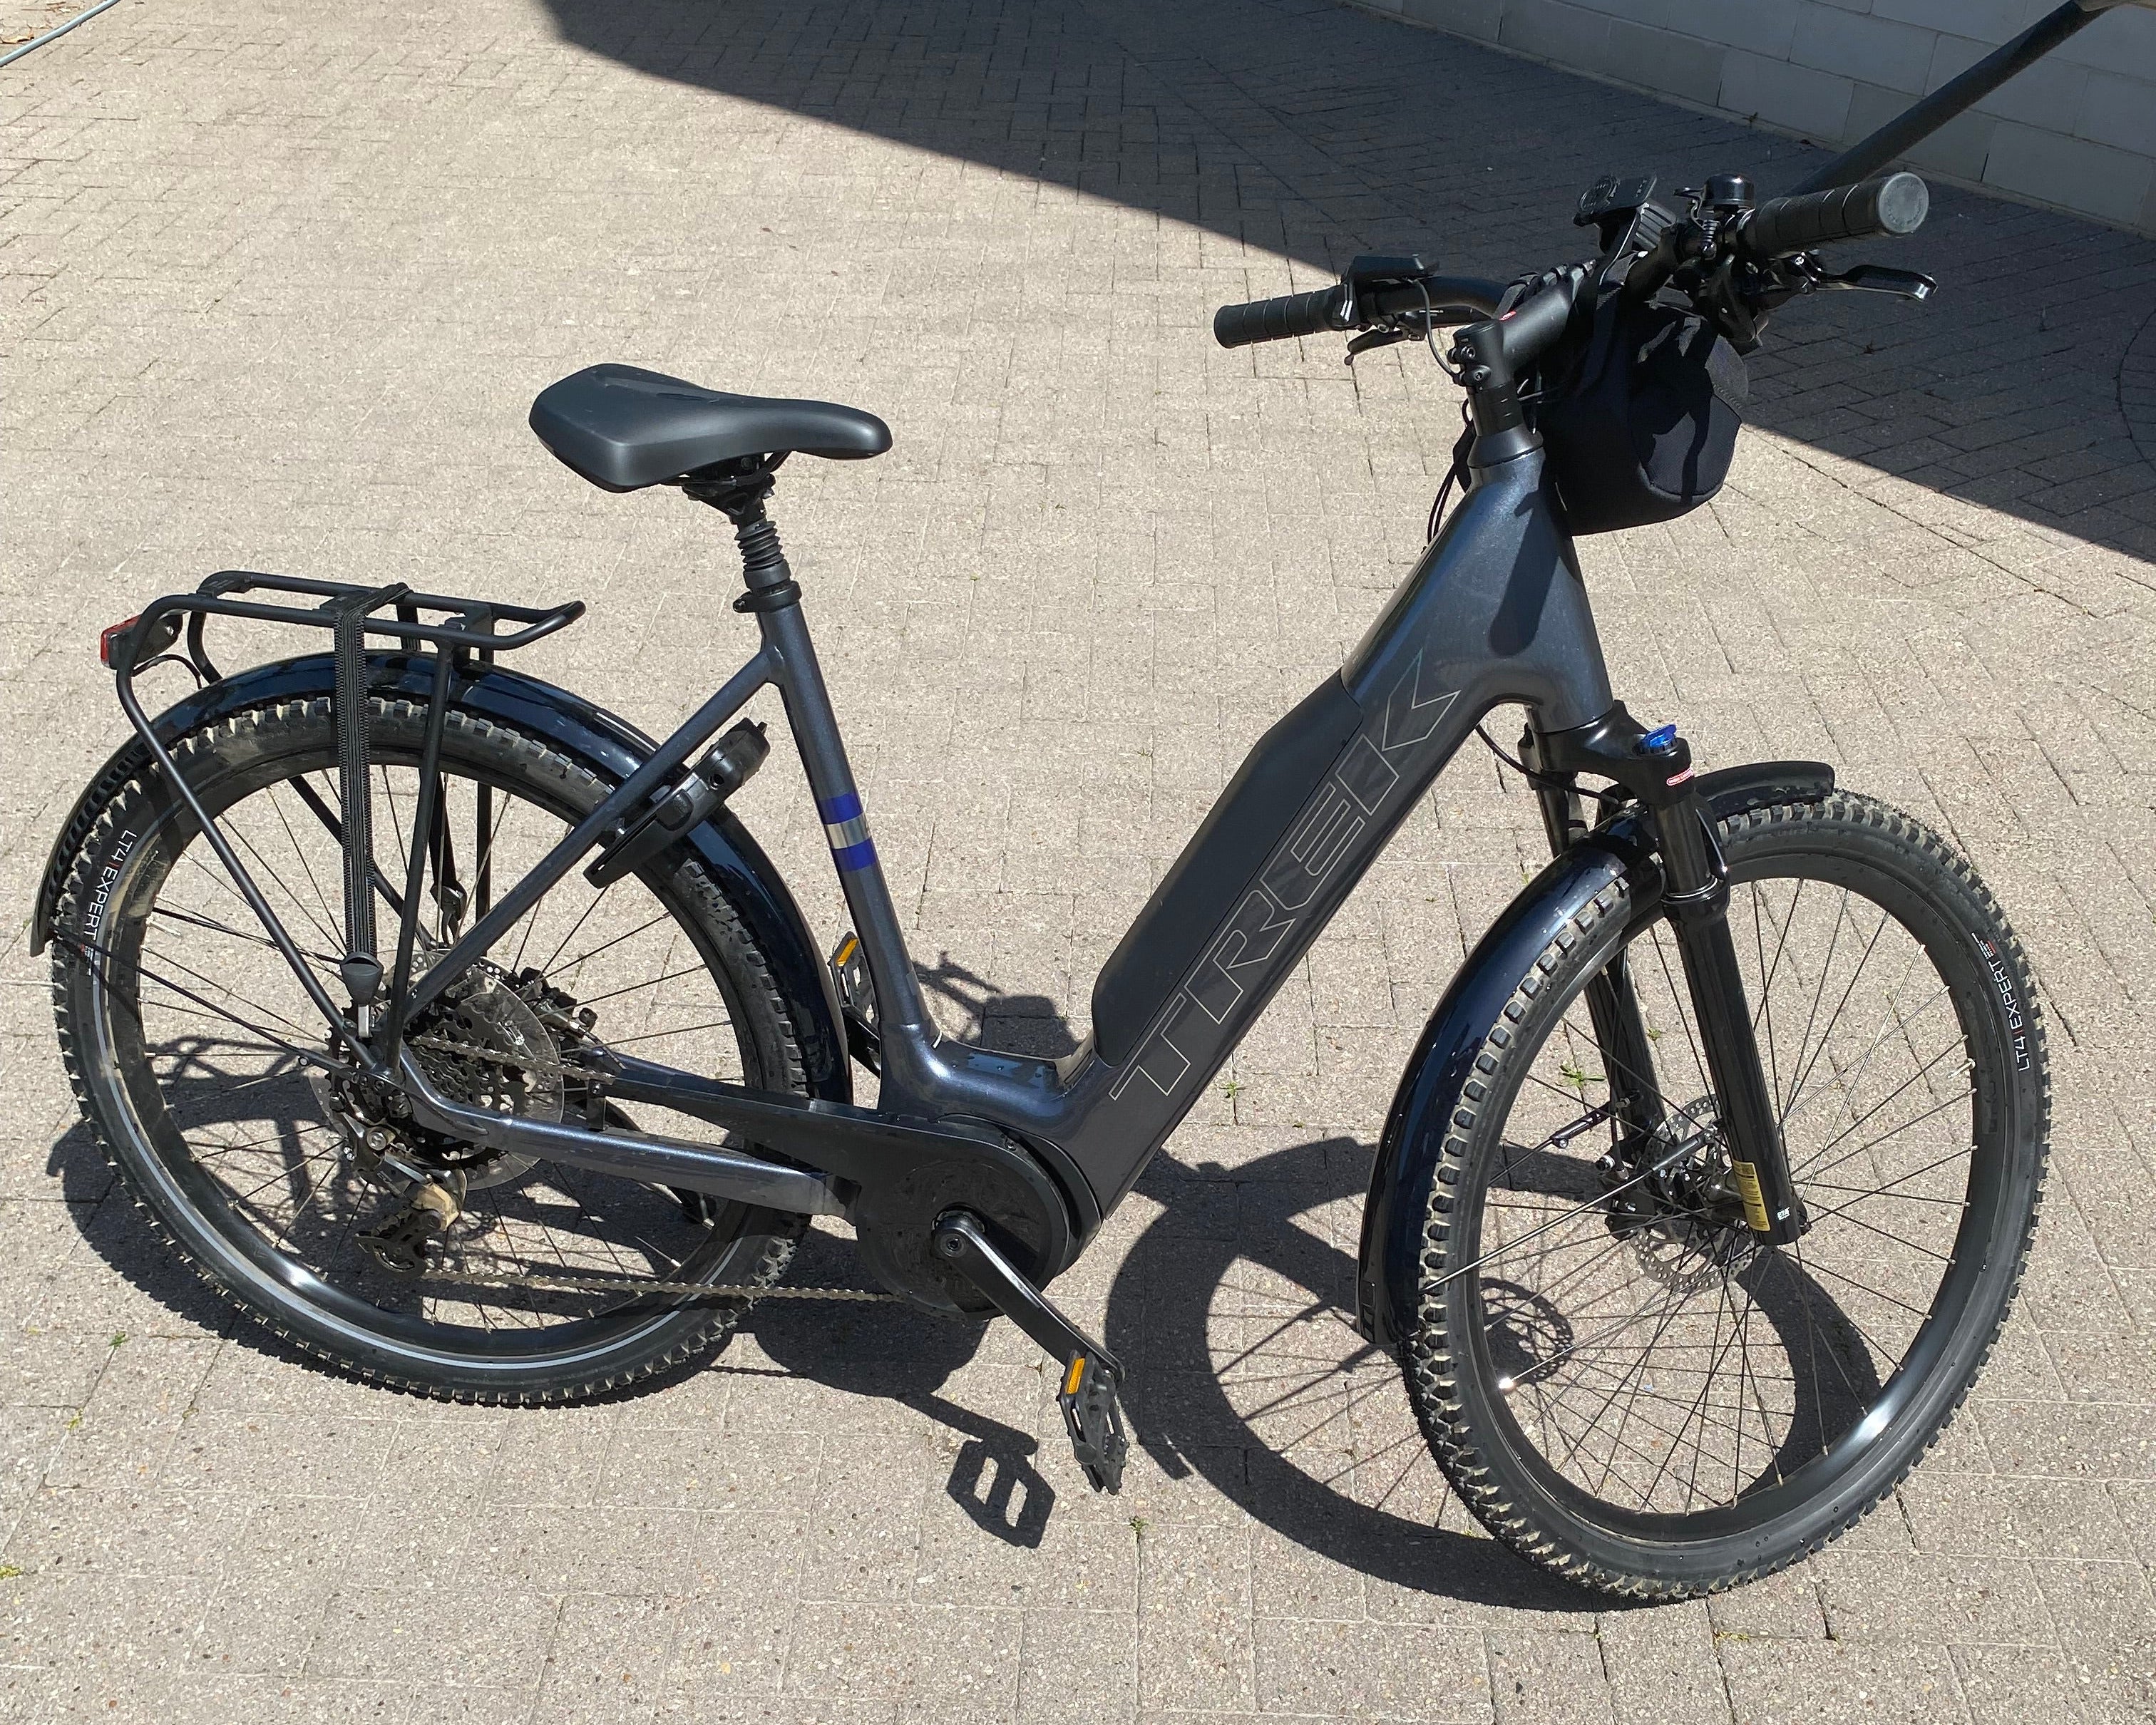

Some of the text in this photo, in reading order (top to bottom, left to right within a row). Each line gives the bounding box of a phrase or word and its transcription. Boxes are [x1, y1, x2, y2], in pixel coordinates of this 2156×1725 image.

[111, 830, 138, 861] LT4
[1109, 648, 1461, 1100] TREK
[83, 867, 118, 941] EXPERT
[1988, 960, 2031, 1071] LT4 EXPERT
